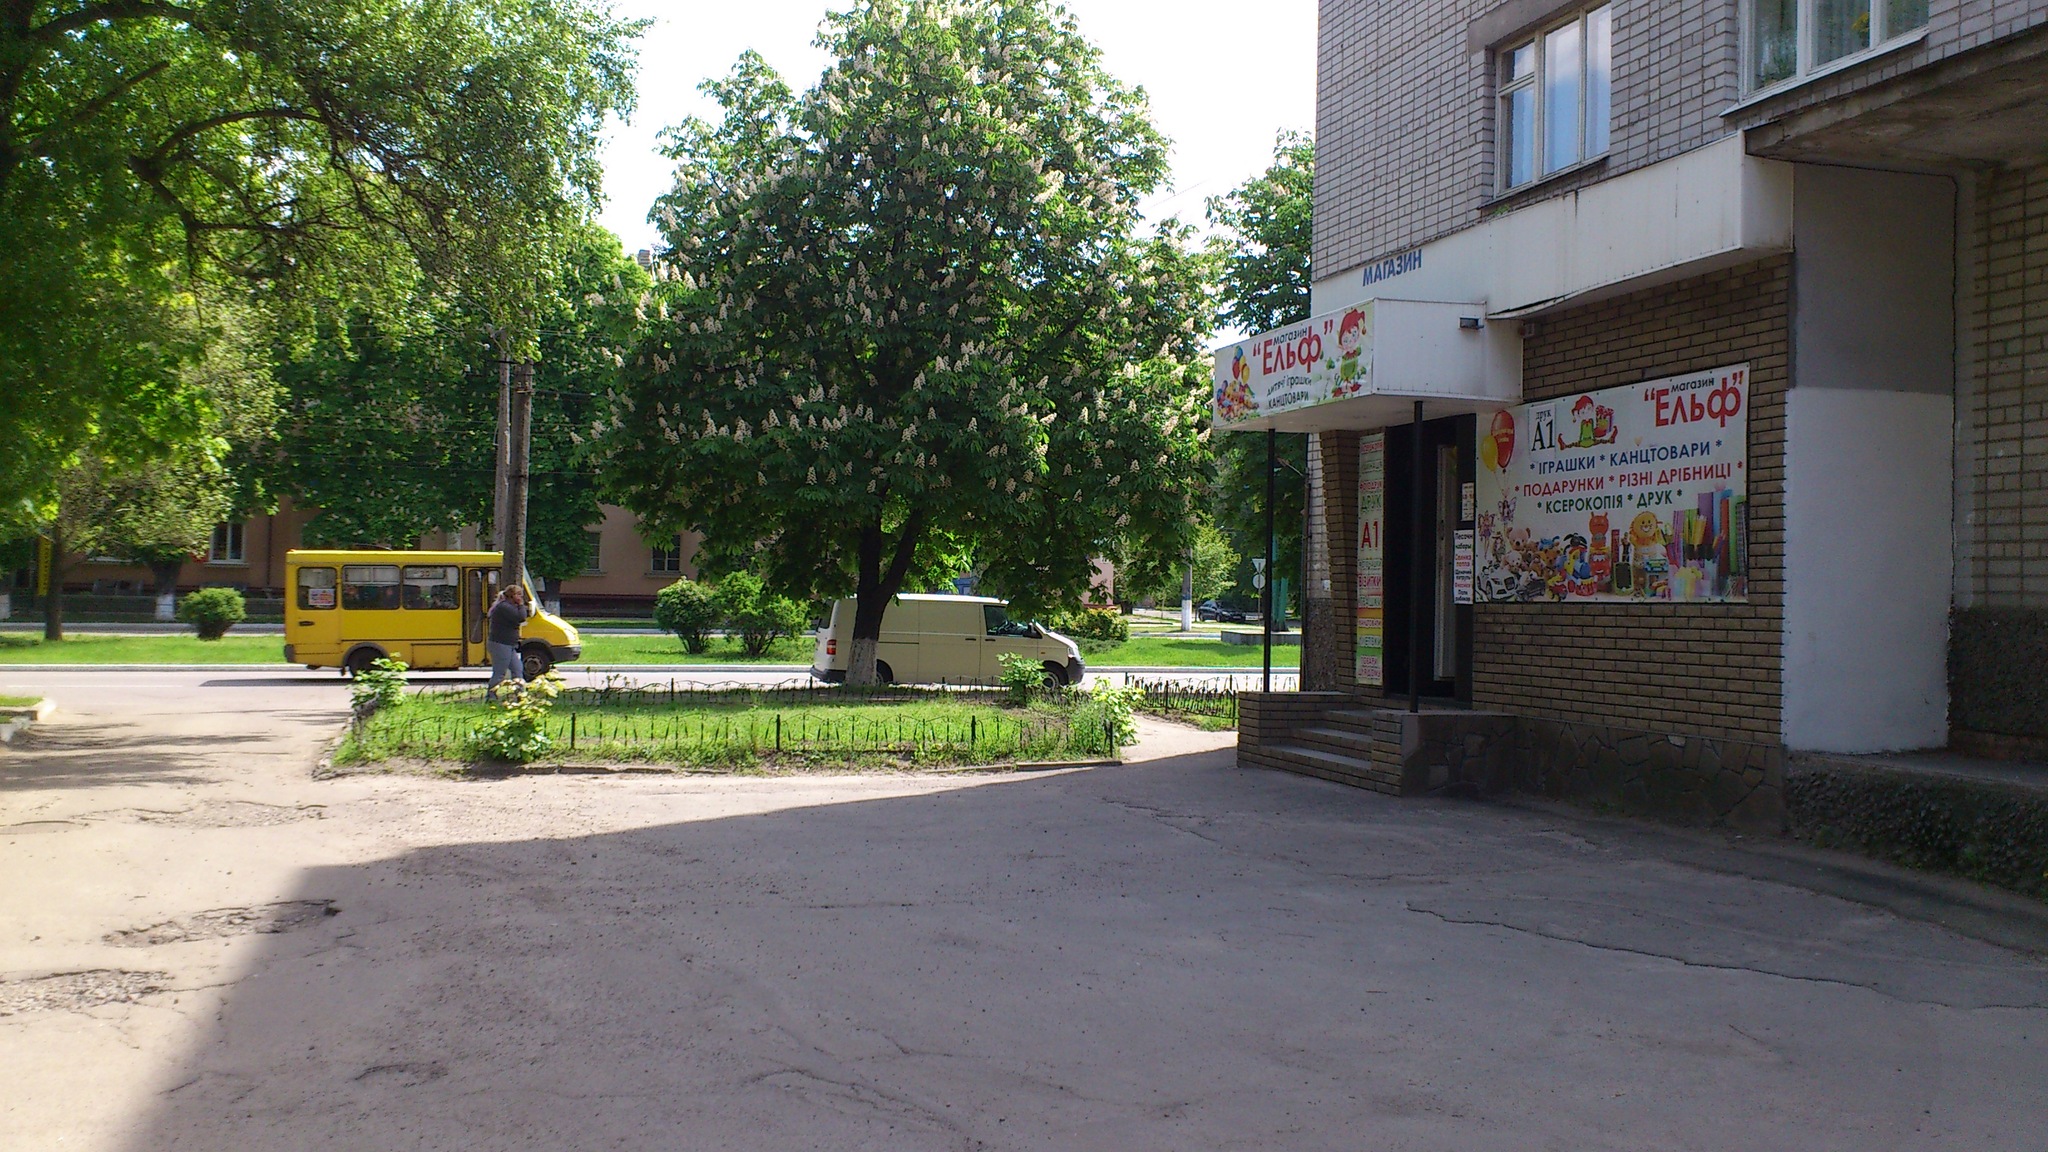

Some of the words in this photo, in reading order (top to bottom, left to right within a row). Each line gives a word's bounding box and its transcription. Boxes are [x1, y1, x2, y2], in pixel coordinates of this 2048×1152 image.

[1362, 249, 1422, 287] МАГАЗИН
[1273, 327, 1308, 346] магазин
[1671, 377, 1715, 393] магазин
[1268, 390, 1309, 409] КАНЦТОВАРИ
[1538, 455, 1596, 475] ІГРАШКИ
[1609, 440, 1711, 467] КАНЦТОВАРИ
[1523, 476, 1604, 497] ПОДАРУНКИ
[1619, 469, 1653, 488] РІЗНІ
[1656, 462, 1732, 487] ДРІБНИЦІ
[1545, 494, 1623, 514] КСЕРОКОПІЯ
[1636, 489, 1673, 508] ДРУК
